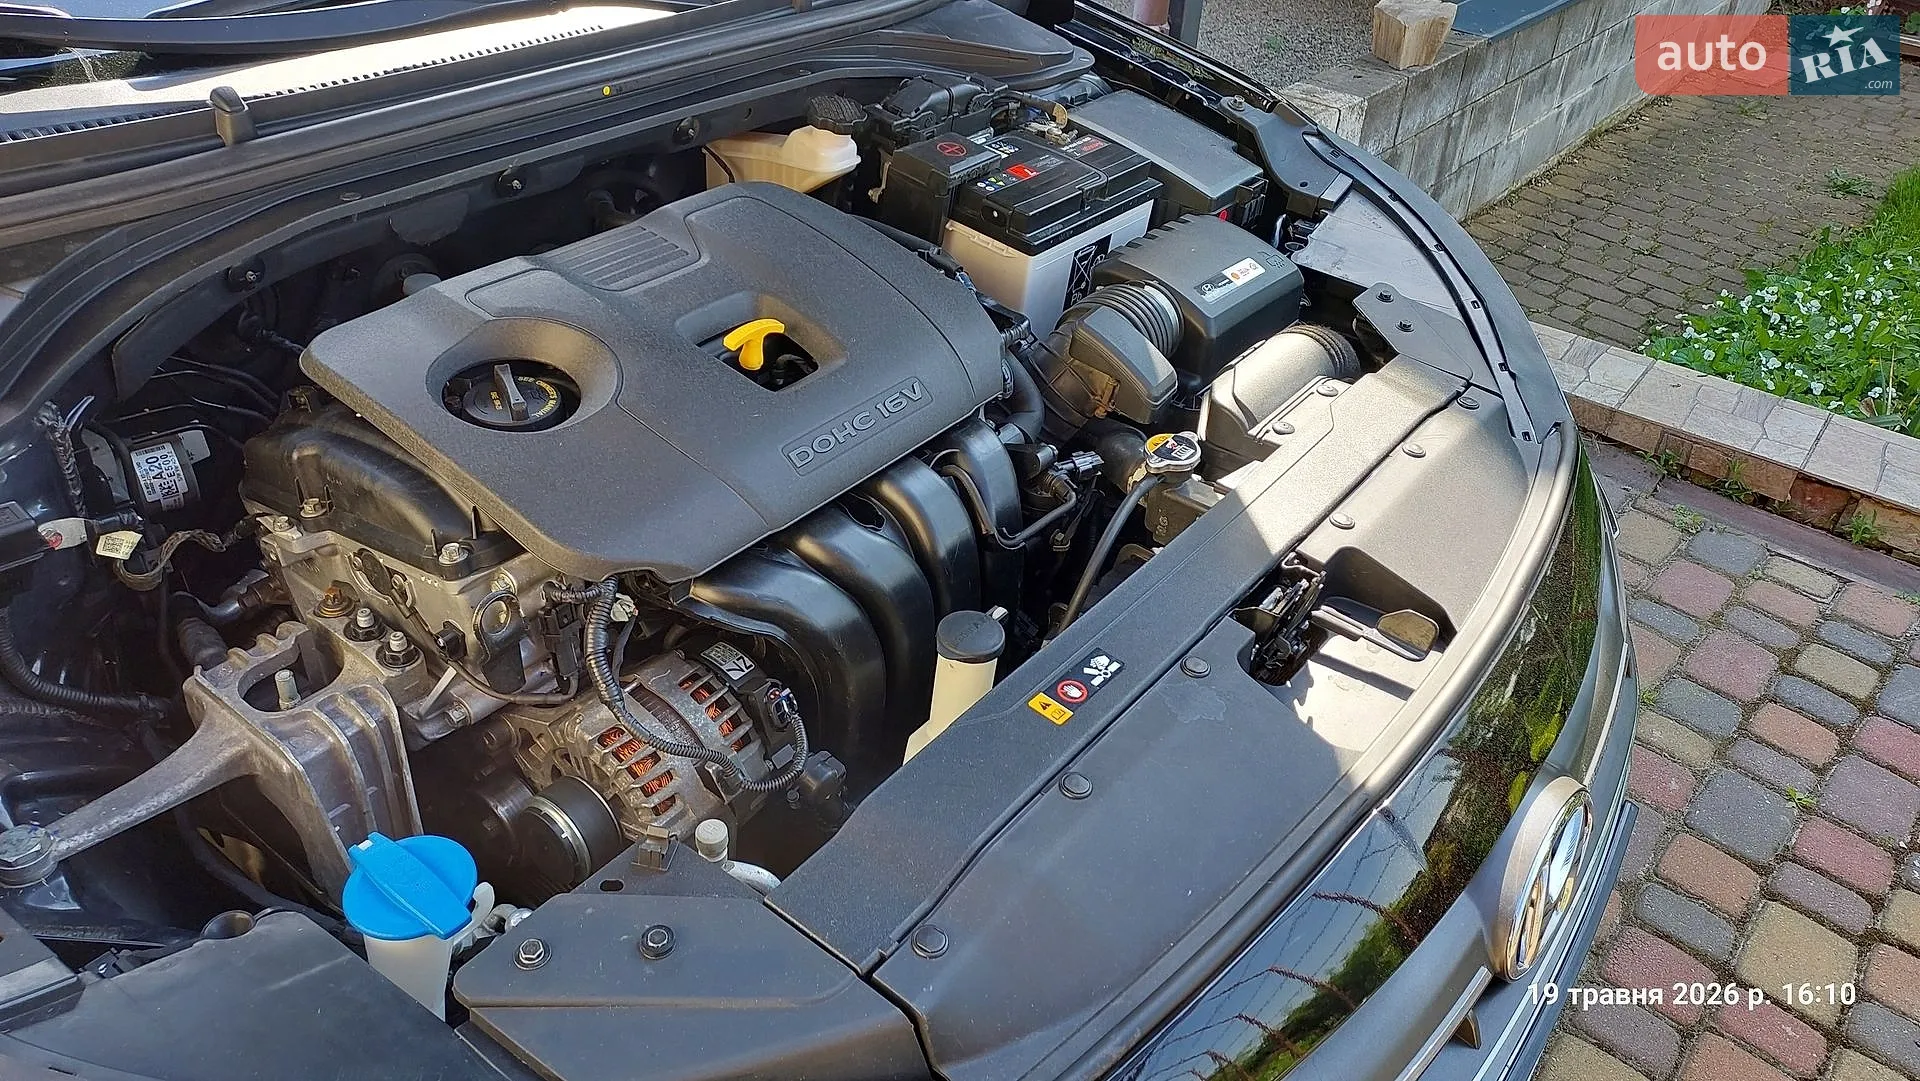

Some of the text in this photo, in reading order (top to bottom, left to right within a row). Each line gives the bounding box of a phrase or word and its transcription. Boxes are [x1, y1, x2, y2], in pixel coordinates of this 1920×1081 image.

[531, 399, 557, 418] MANUAL
[788, 381, 923, 468] DOHC 16V
[145, 456, 164, 480] A20
[160, 454, 176, 479] E500
